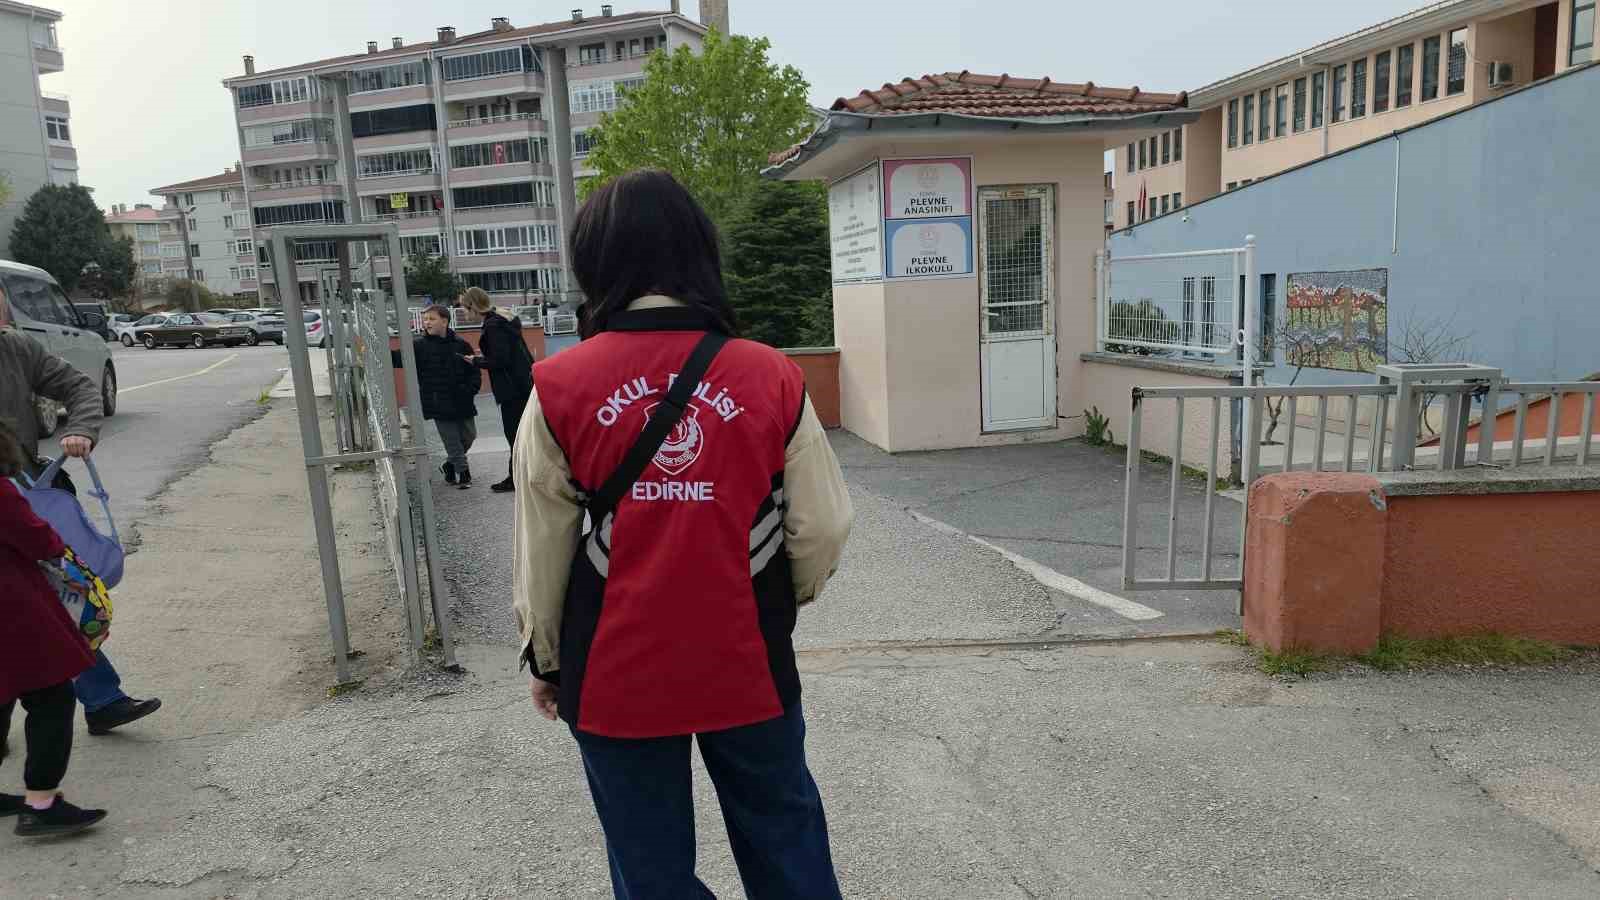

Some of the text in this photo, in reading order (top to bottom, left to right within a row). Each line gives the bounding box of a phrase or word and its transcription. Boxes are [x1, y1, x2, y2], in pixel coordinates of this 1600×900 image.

[910, 197, 948, 206] PLEVNE
[911, 256, 949, 265] PLEVNE
[596, 376, 659, 426] OKUL
[631, 477, 714, 501] EDİRNE
